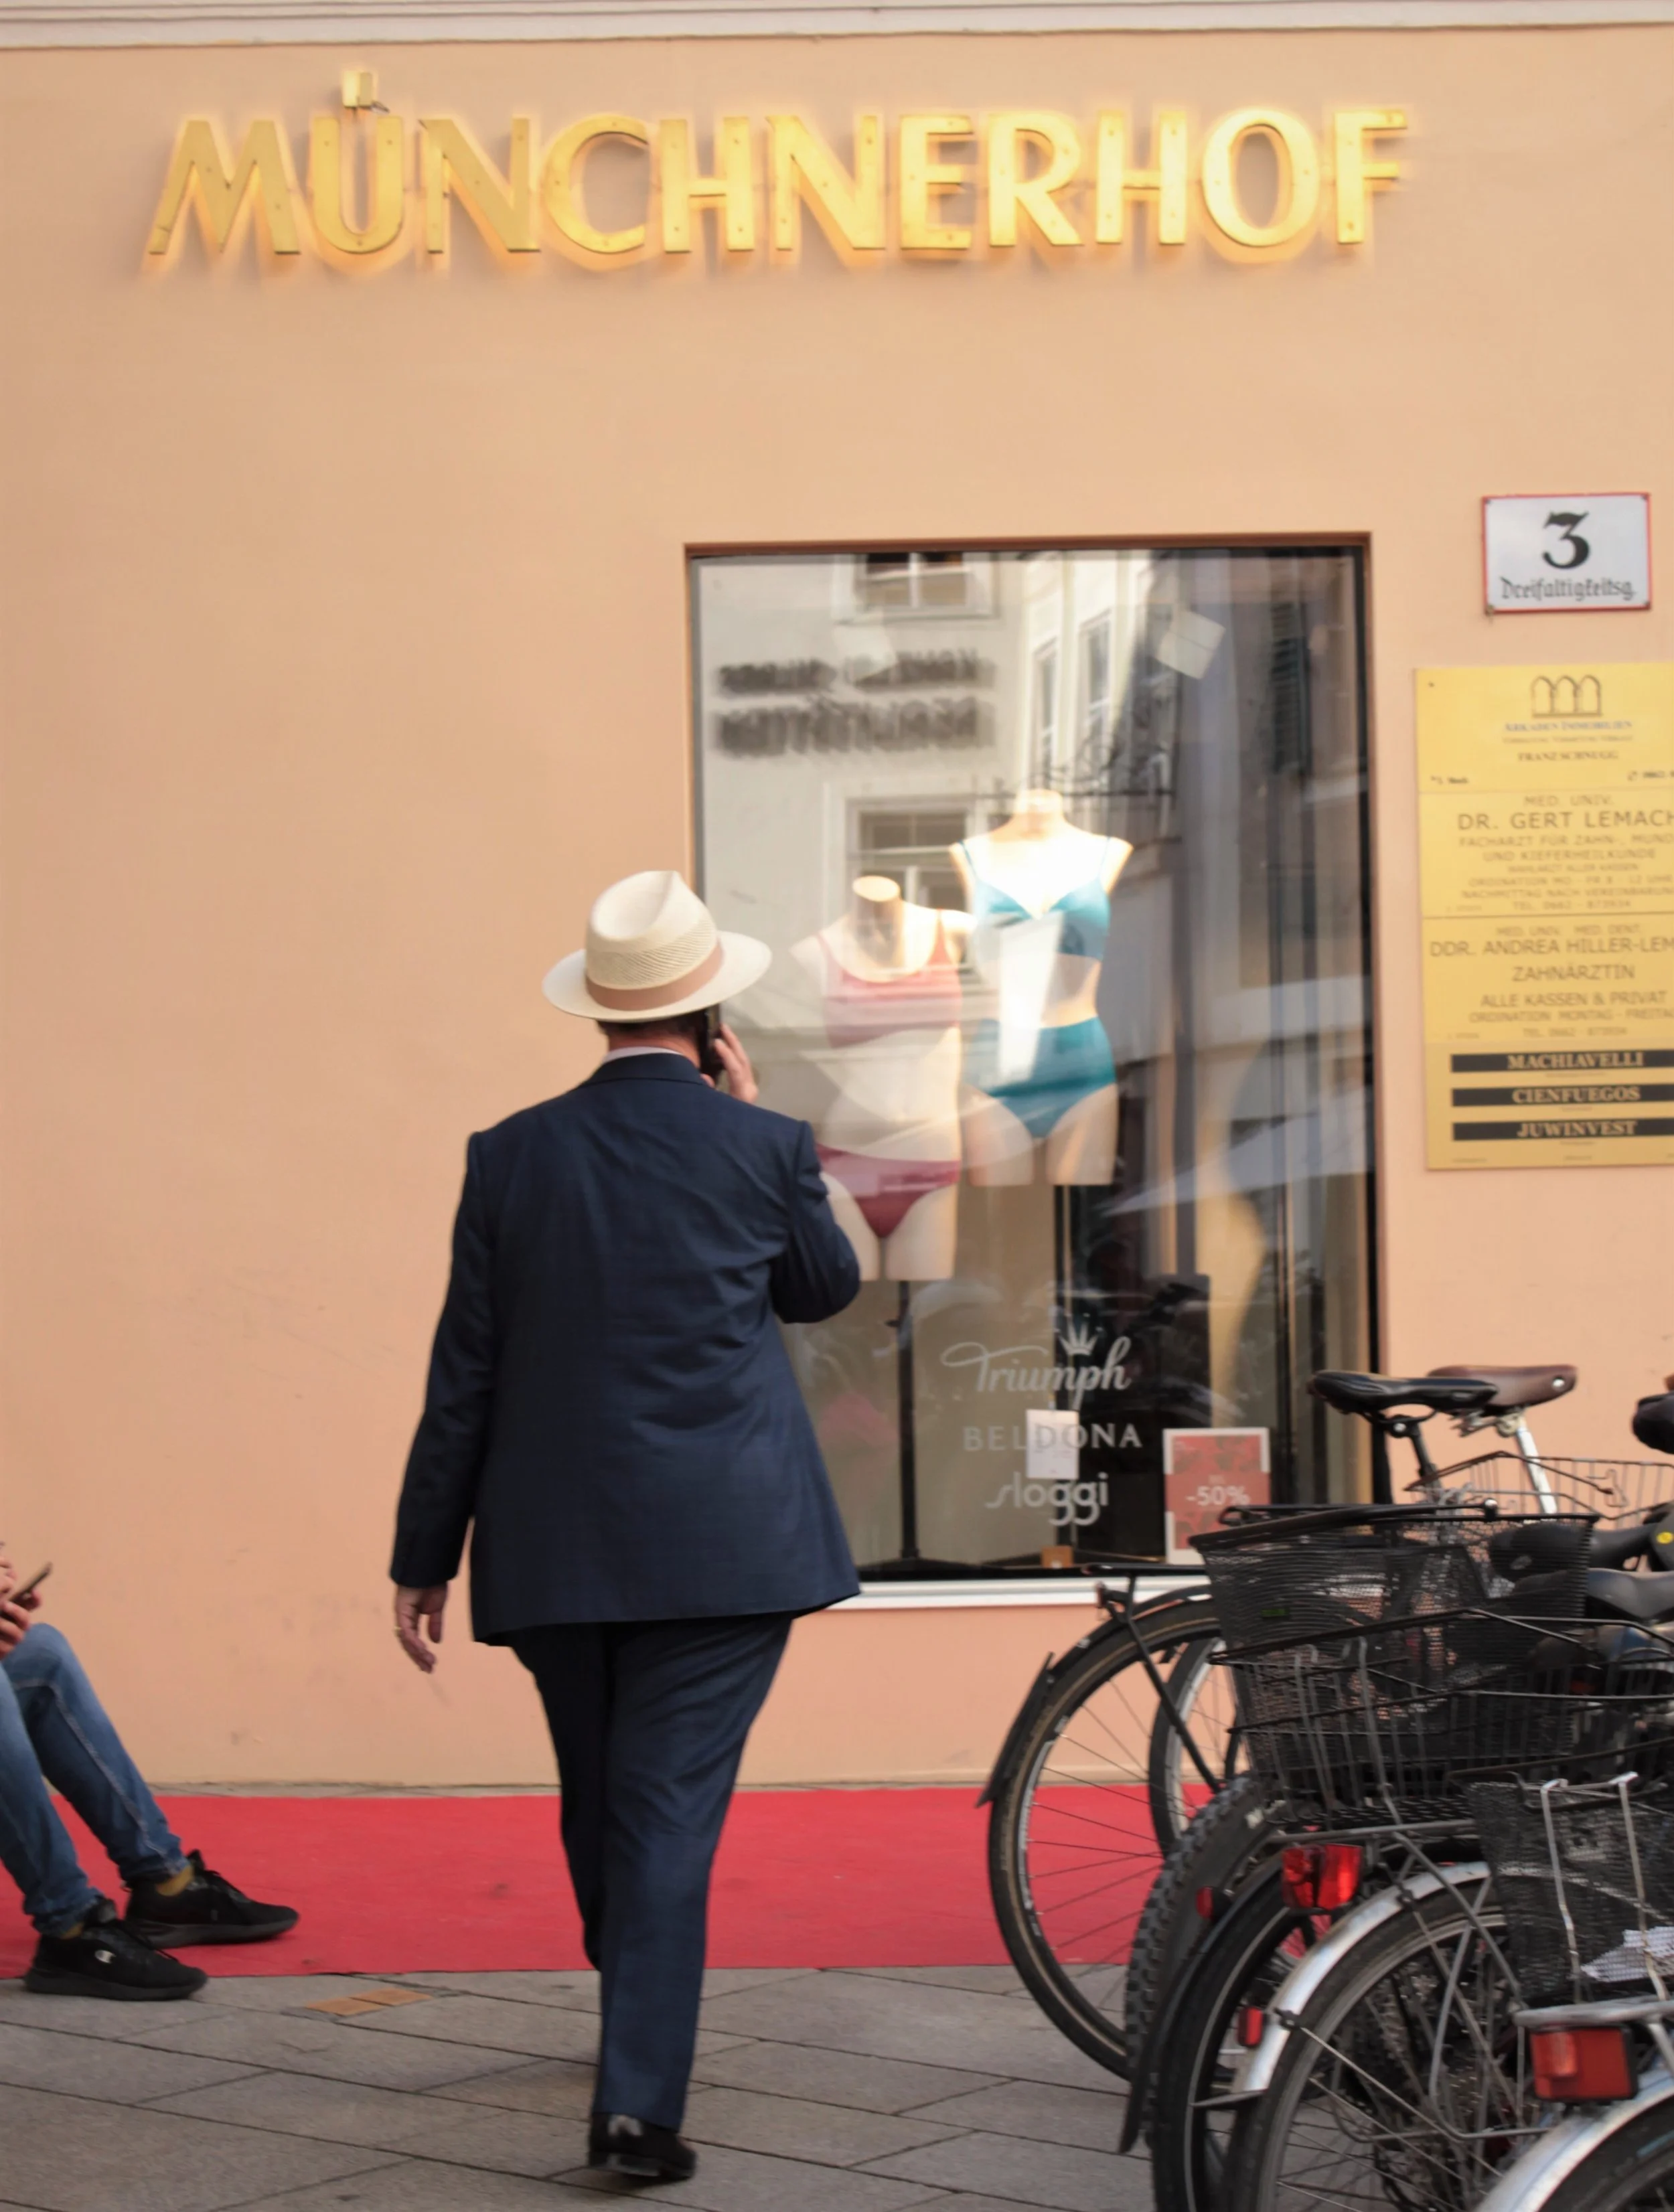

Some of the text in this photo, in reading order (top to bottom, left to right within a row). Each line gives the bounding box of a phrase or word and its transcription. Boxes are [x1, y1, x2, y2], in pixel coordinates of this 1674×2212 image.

[147, 70, 1409, 256] MÜNCHNERHOF
[1543, 511, 1590, 570] 3
[1458, 813, 1499, 830] DR.
[1511, 811, 1572, 829] GERT
[1482, 939, 1560, 955] ANDREA
[1507, 1052, 1644, 1069] MACHIAVELLI
[1511, 1087, 1641, 1103] CIENFUEGOS
[1517, 1121, 1638, 1137] JUWINVEST
[941, 1336, 1132, 1410] Triumph
[963, 1423, 1142, 1450] BELDONA
[985, 1472, 1109, 1526] sloggi
[1185, 1484, 1251, 1506] -50%
